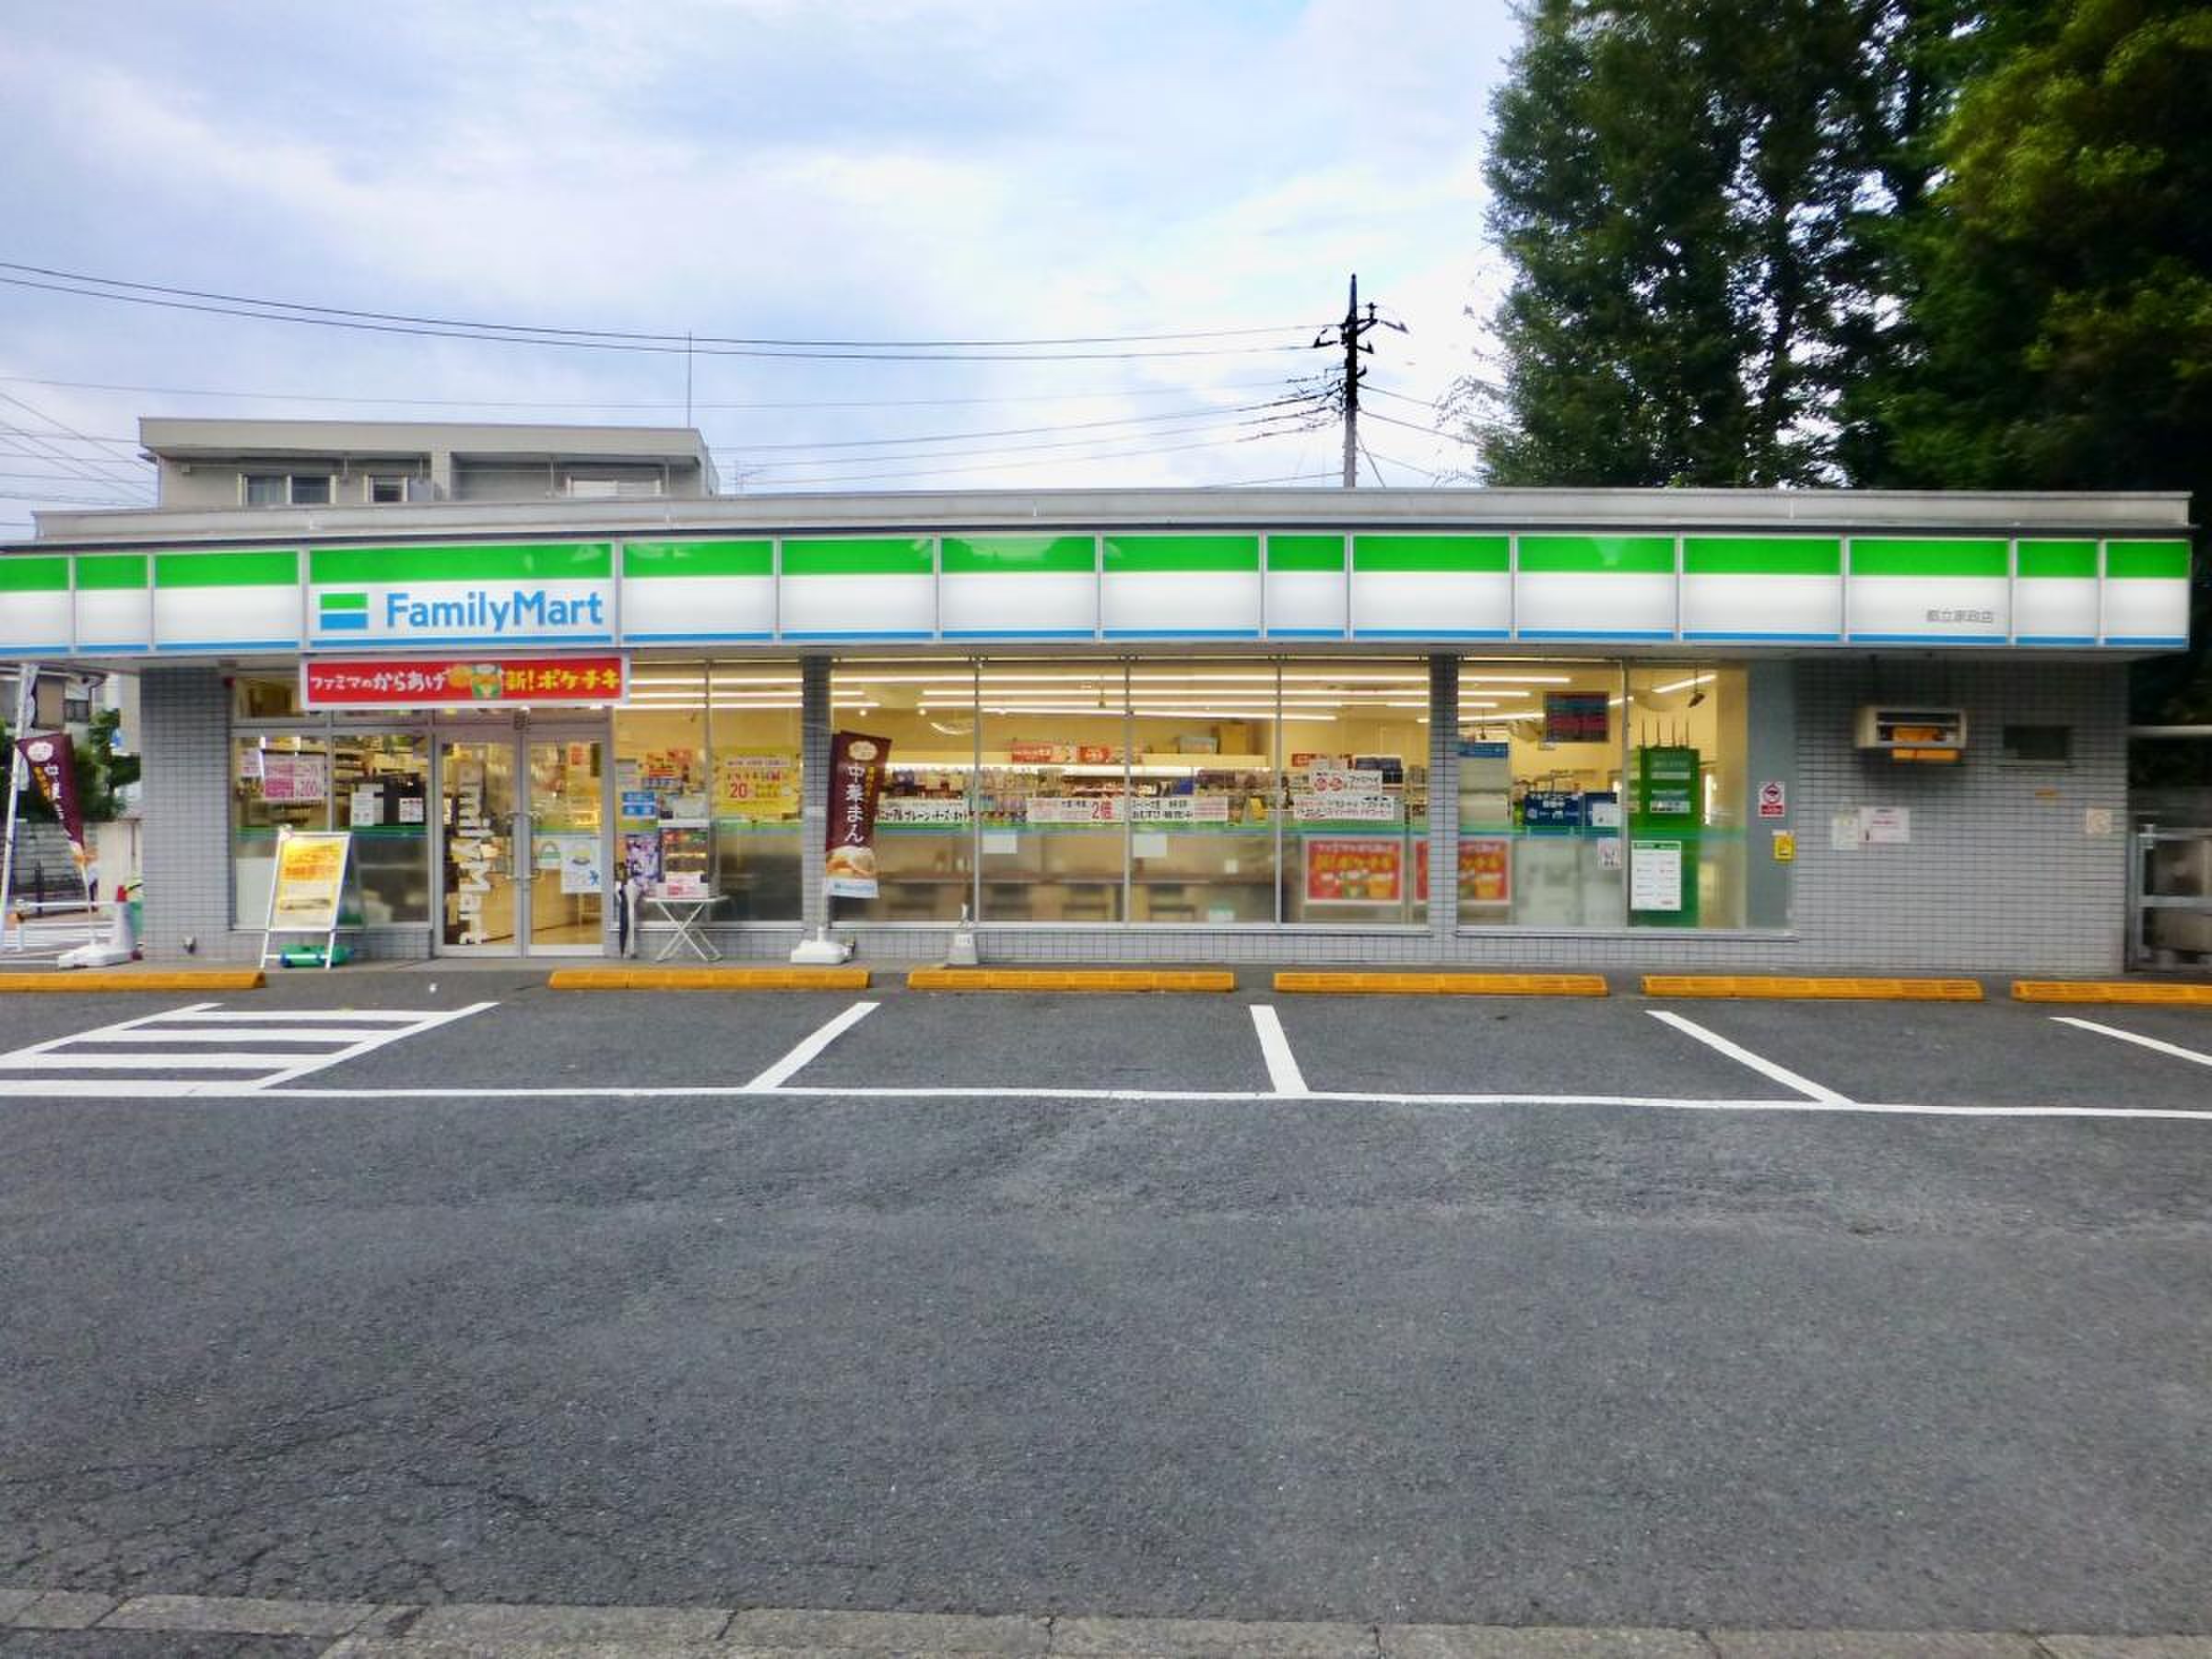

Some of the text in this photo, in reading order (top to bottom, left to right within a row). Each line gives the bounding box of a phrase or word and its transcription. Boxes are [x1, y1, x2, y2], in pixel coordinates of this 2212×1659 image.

[385, 590, 605, 631] FamilyMart
[309, 668, 446, 691] ファミマのからあげ
[844, 762, 865, 843] 中華まん
